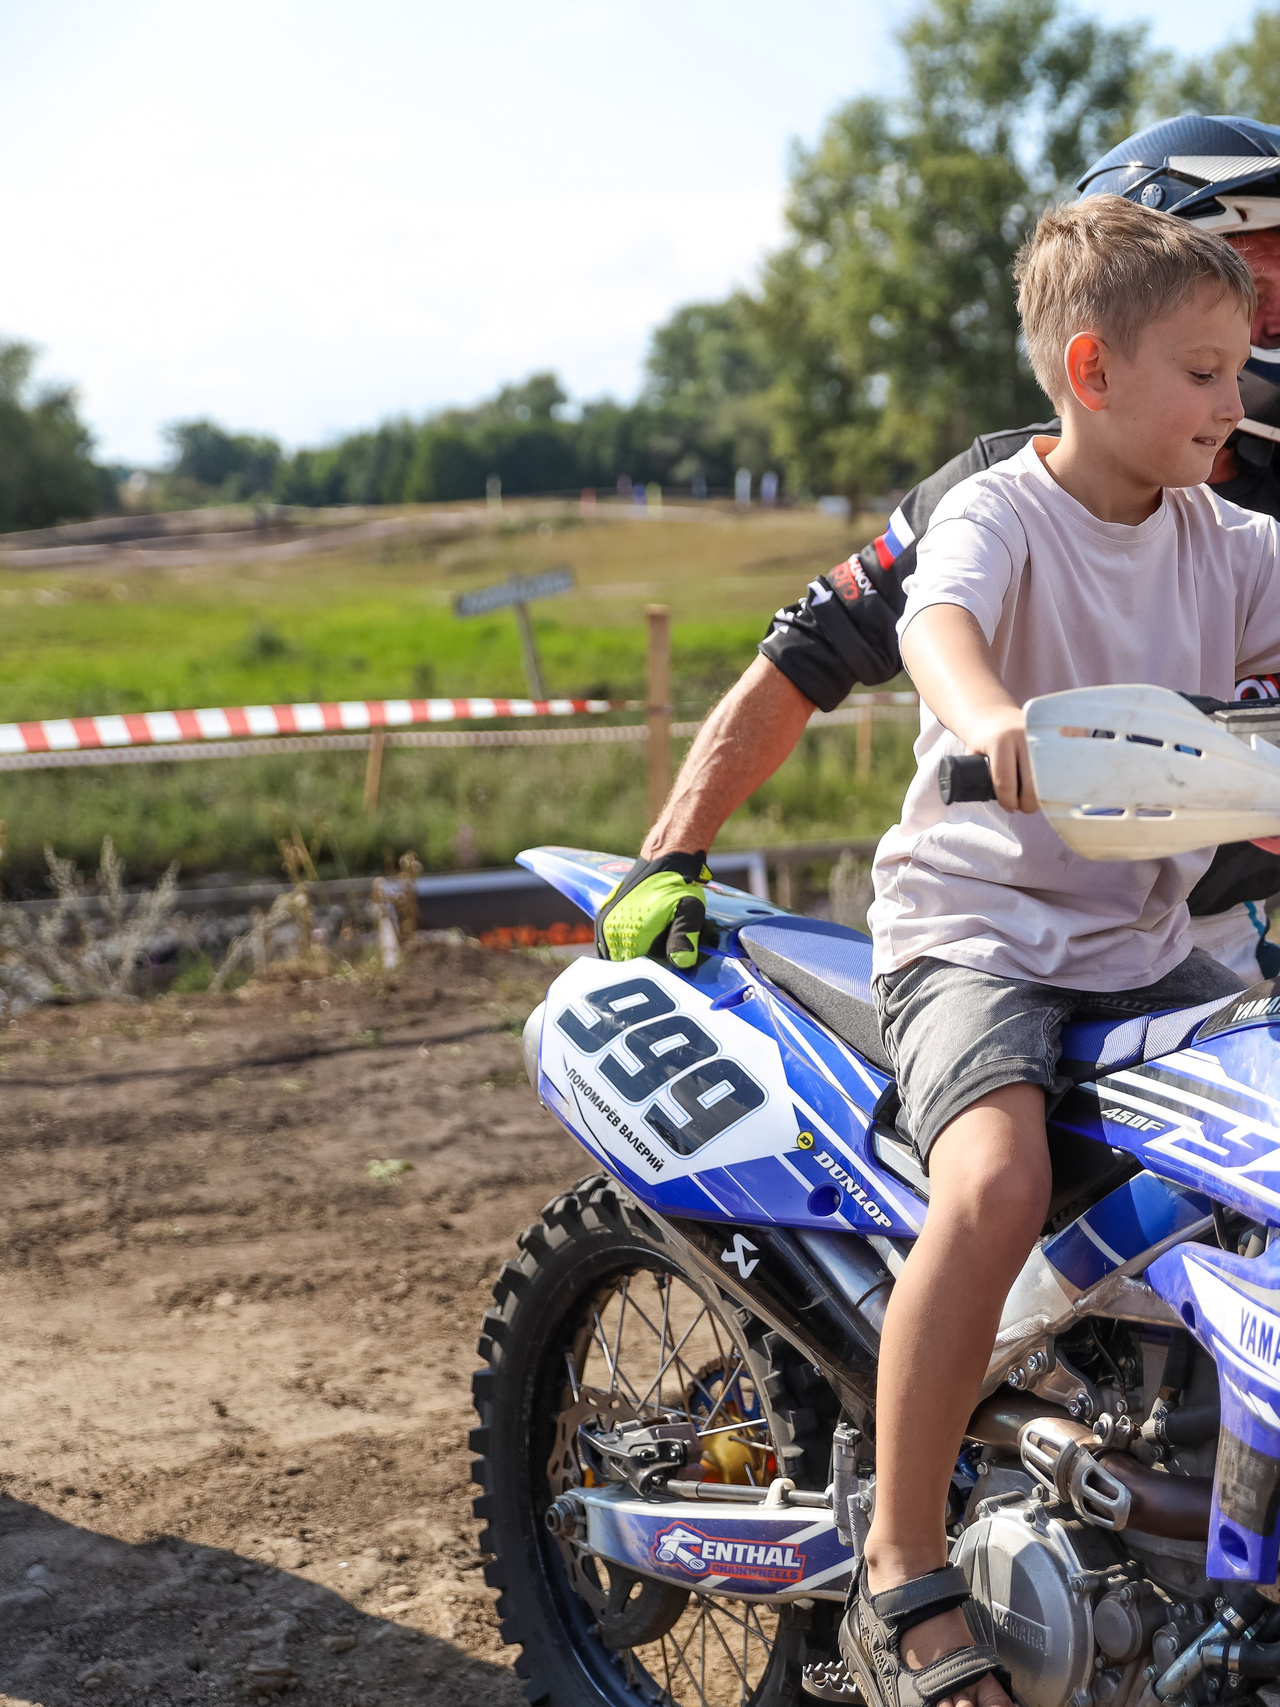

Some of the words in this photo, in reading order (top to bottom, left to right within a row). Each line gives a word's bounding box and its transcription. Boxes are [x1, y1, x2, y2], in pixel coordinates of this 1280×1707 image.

[555, 976, 768, 1157] 999
[566, 1067, 621, 1128] ПОНОМАРЁВ
[618, 1123, 665, 1173] ВАЛЕРИЙ
[1100, 1107, 1166, 1132] 450F
[812, 1150, 893, 1228] DUNLOP
[656, 1527, 801, 1570] RENTHAL
[711, 1563, 799, 1581] CHAINWHEELS
